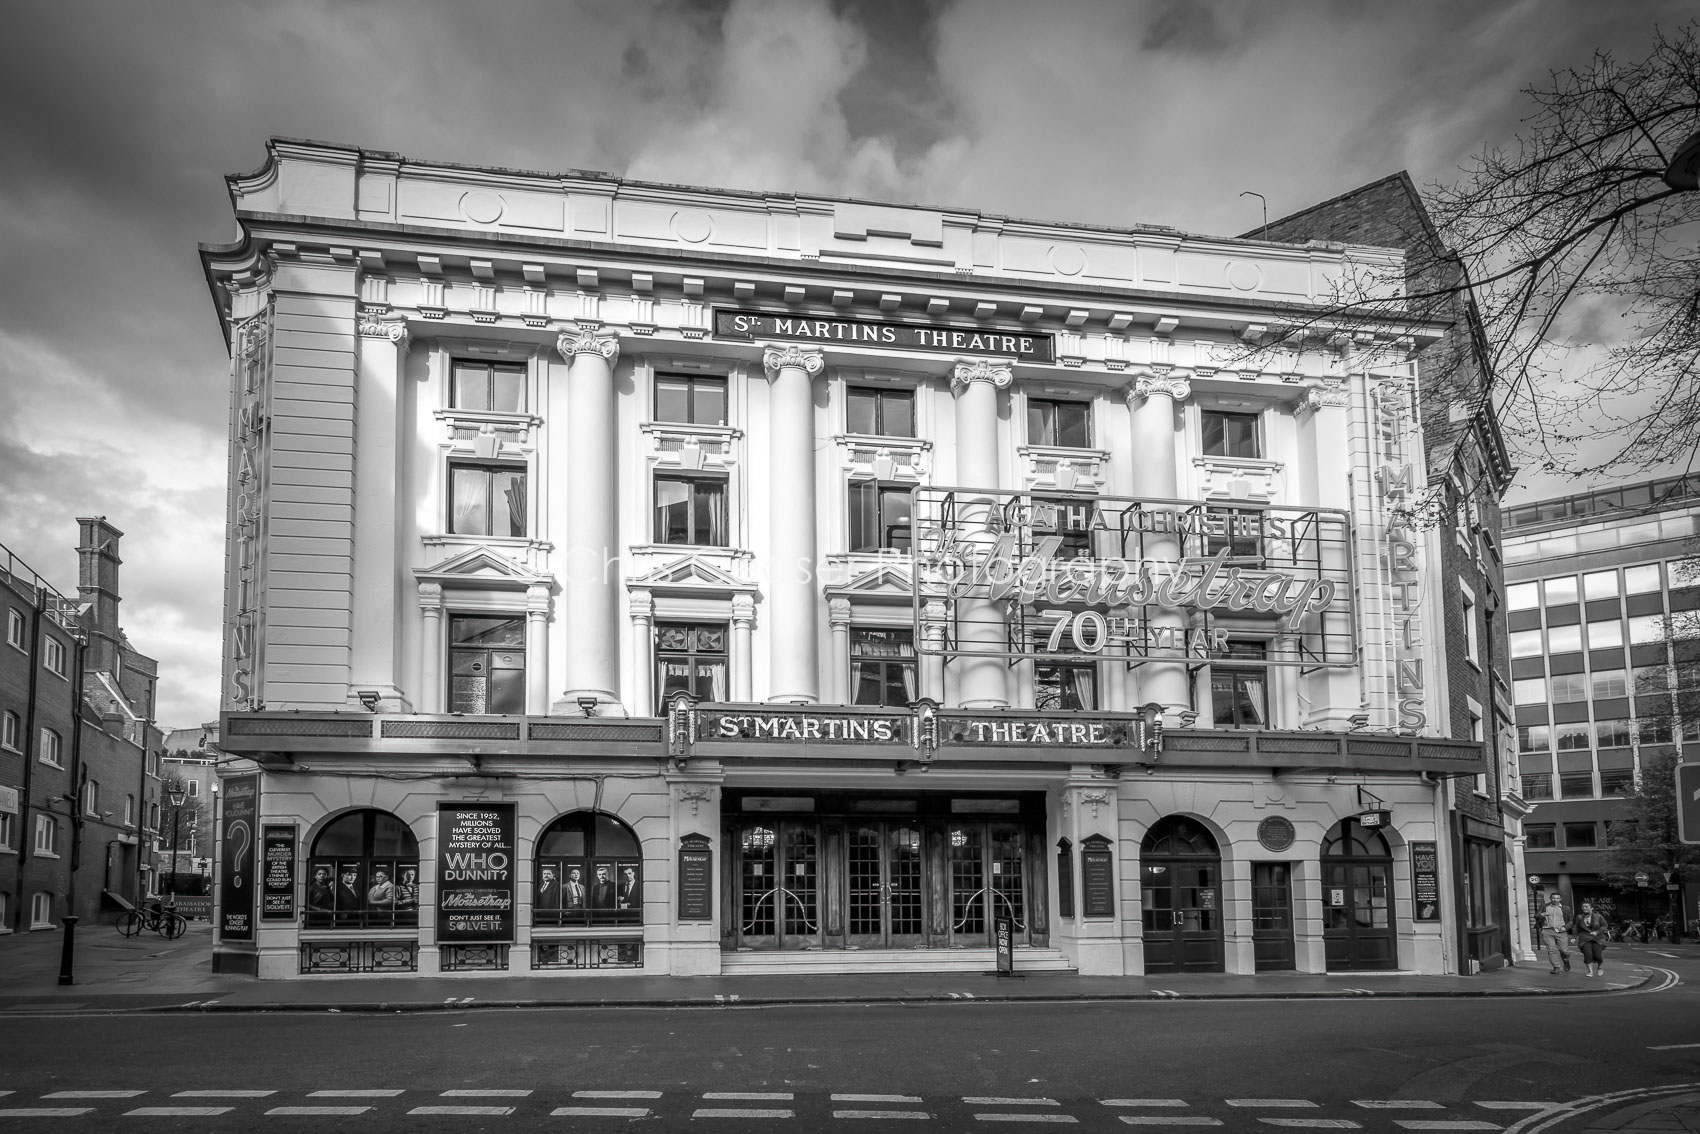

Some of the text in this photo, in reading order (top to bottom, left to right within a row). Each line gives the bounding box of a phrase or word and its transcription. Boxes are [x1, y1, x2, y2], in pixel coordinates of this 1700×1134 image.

[774, 318, 897, 343] MARTINS
[914, 329, 1035, 354] THEATRE
[983, 501, 1287, 540] AGATHA CHRISTIE'S
[921, 526, 978, 562] The
[947, 533, 1338, 629] Mousetrap
[1149, 625, 1231, 654] YEAR
[754, 716, 893, 741] MARTIN'S
[971, 721, 1108, 744] THEATRE
[456, 812, 500, 820] SINCE 1952,
[445, 852, 508, 870] WHO
[1415, 860, 1436, 868] YOU
[445, 870, 508, 881] DUNNIT?
[441, 893, 512, 909] Mousetrap
[464, 892, 475, 900] The
[449, 921, 503, 931] SOLVE IT.
[998, 938, 1008, 947] NOW
